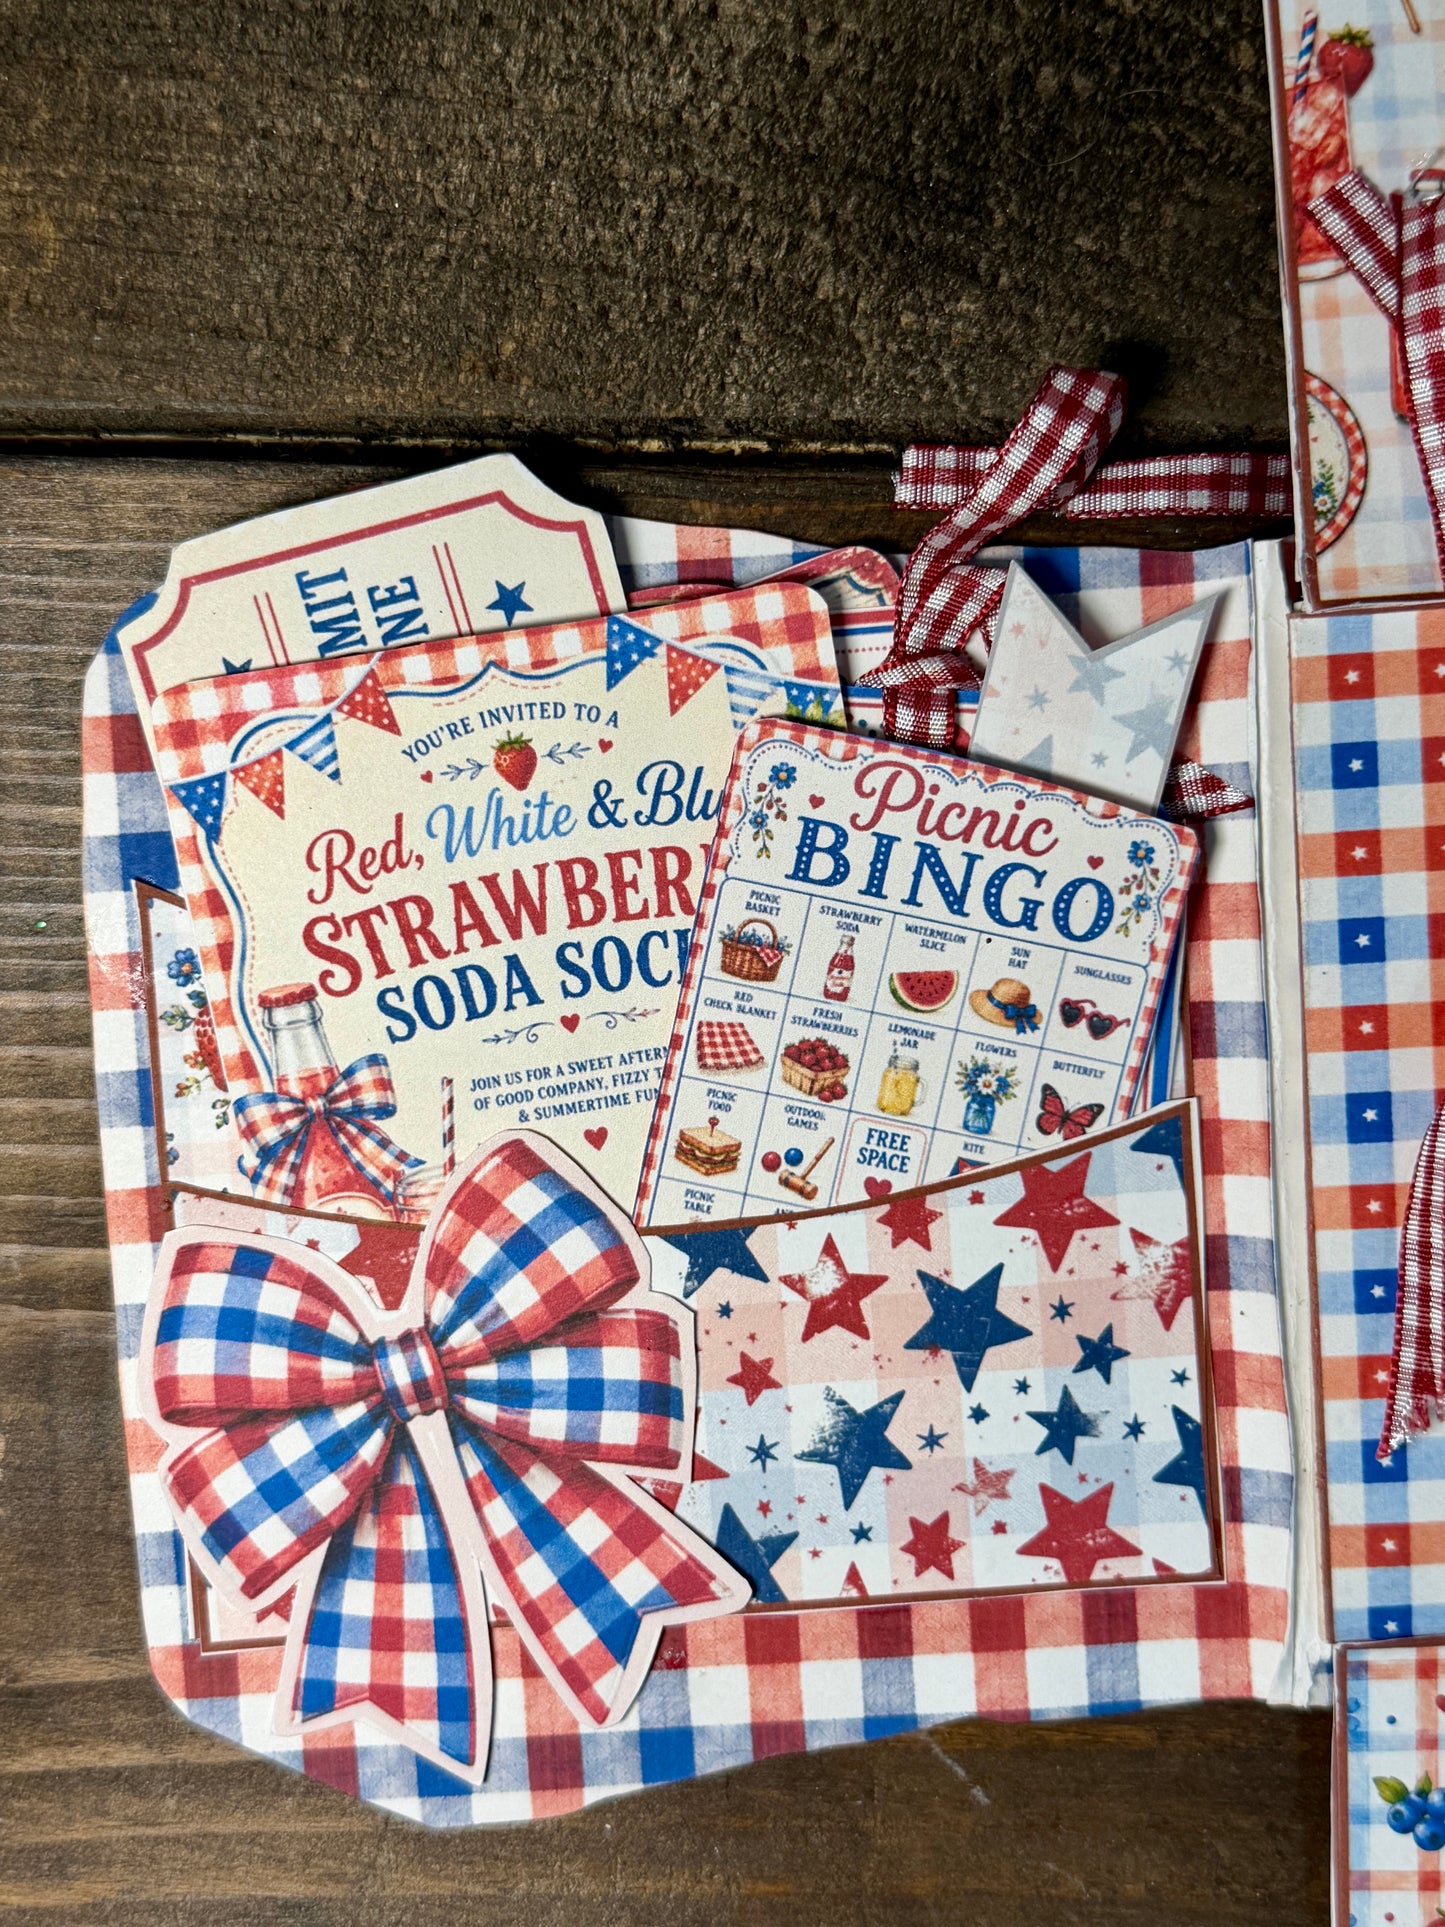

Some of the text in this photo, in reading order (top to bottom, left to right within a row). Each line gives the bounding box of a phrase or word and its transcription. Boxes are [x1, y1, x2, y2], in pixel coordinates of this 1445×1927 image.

[401, 701, 619, 763] YOU'RE INVITED TO A
[849, 760, 1059, 857] Picnic
[305, 760, 723, 905] Red, White & Blu
[784, 815, 1114, 943] BINGO
[750, 890, 781, 906] PICNIC
[745, 901, 781, 917] BASKET
[819, 905, 883, 927] STRAWBERRY
[302, 843, 713, 997] STRAWBER
[835, 920, 860, 934] SODA
[904, 923, 968, 945] WATERMELON
[919, 938, 947, 952] SLICE
[1010, 946, 1031, 959] SUN
[1008, 957, 1028, 970] HAT
[1074, 965, 1132, 985] SUNGLASSES
[376, 953, 545, 1044] SODA
[734, 990, 753, 1003] RED
[703, 997, 777, 1020] CHECK BLANKET
[812, 1006, 843, 1022] FRESH
[790, 1015, 859, 1038] STRAWBERRIES
[888, 1022, 936, 1041] LEMONADE
[900, 1037, 919, 1049] JAR
[974, 1041, 1017, 1058] FLOWERS
[470, 1075, 502, 1092] JOIN
[504, 1071, 522, 1086] US
[525, 1066, 552, 1082] FOR
[556, 1064, 565, 1077] A
[568, 1055, 613, 1075] SWEET
[1052, 1059, 1106, 1080] BUTTERFLY
[473, 1096, 490, 1111] OF
[495, 1089, 534, 1107] GOOD
[537, 1076, 608, 1099] COMPANY,
[612, 1069, 650, 1087] FIZZY
[706, 1087, 737, 1102] PICNIC
[518, 1108, 530, 1123] &
[534, 1092, 631, 1120] SUMMERTIME
[708, 1100, 732, 1113] FOOD
[787, 1117, 819, 1131] GAMES
[866, 1127, 911, 1153] FREE
[962, 1141, 985, 1155] KITE
[856, 1147, 911, 1173] SPACE
[684, 1188, 715, 1203] PICNIC
[684, 1199, 713, 1215] TABLE
